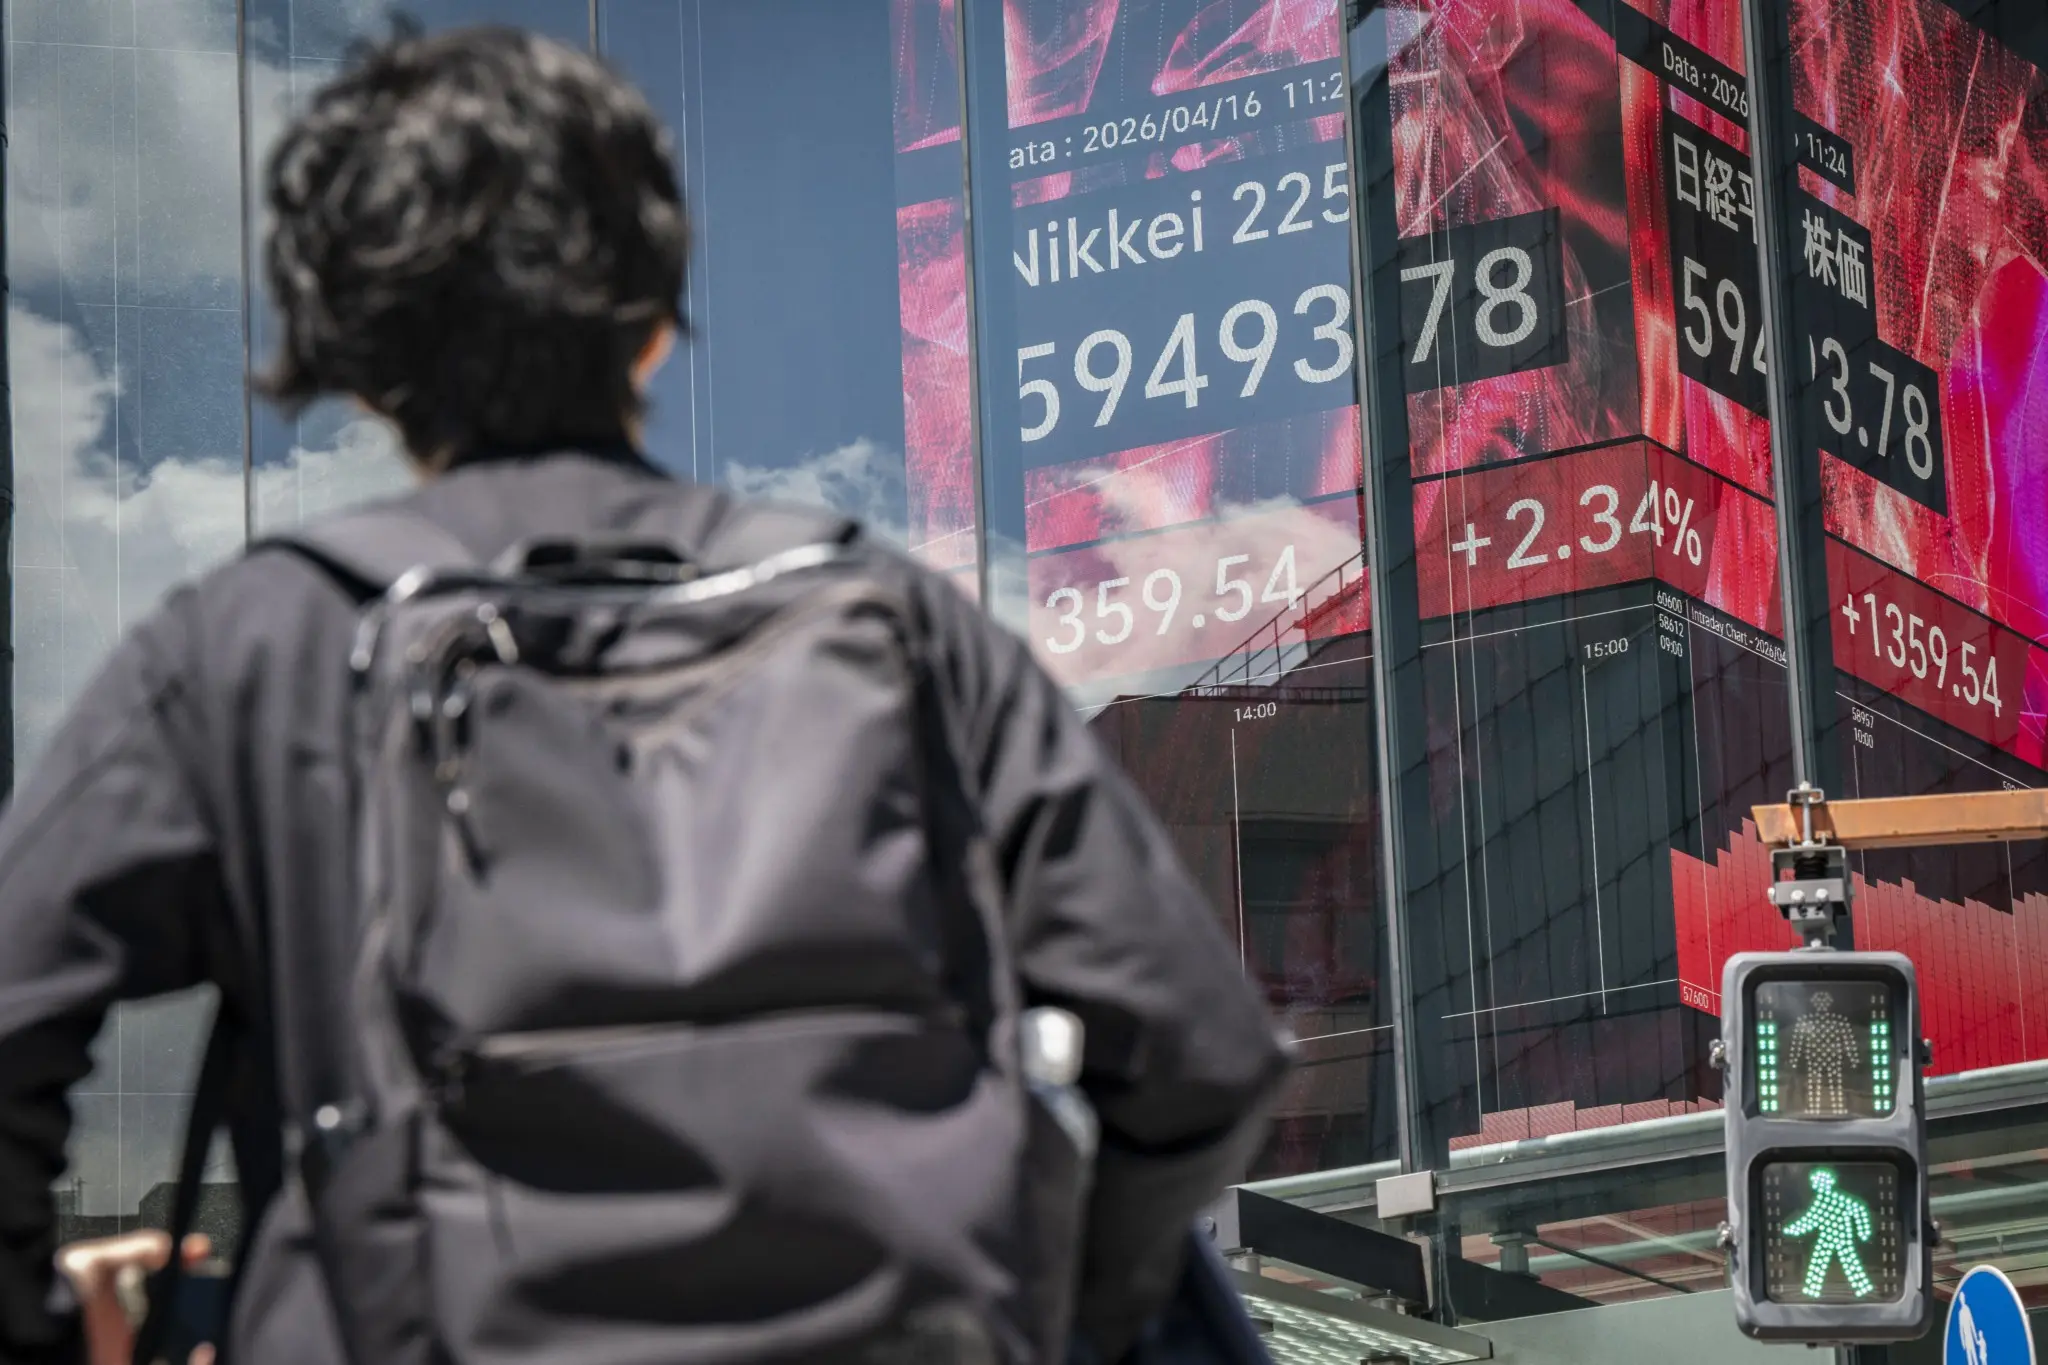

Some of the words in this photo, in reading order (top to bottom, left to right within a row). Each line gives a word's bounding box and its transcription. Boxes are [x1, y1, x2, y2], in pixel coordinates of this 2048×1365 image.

[1083, 91, 1262, 154] 2026/04/16
[1663, 41, 1699, 88] Data
[1711, 73, 1749, 118] 2026
[1806, 133, 1847, 178] 11:24
[1232, 161, 1350, 245] 225
[1802, 208, 1868, 309] 株価
[1017, 283, 1354, 443] 59493
[1400, 246, 1538, 364] 78
[1808, 334, 1934, 480] 3.78
[1046, 545, 1306, 654] 359.54
[1656, 590, 1683, 613] 60600
[1659, 613, 1684, 637] 58612
[1691, 605, 1724, 636] Intraday
[1725, 623, 1748, 645] Chart
[1584, 637, 1629, 659] 15:00
[1660, 634, 1683, 657] 09:00
[1842, 593, 2002, 718] +1359.54
[1233, 701, 1277, 723] 14:00
[1853, 727, 1874, 748] 10:00
[1683, 986, 1709, 1009] 57600
